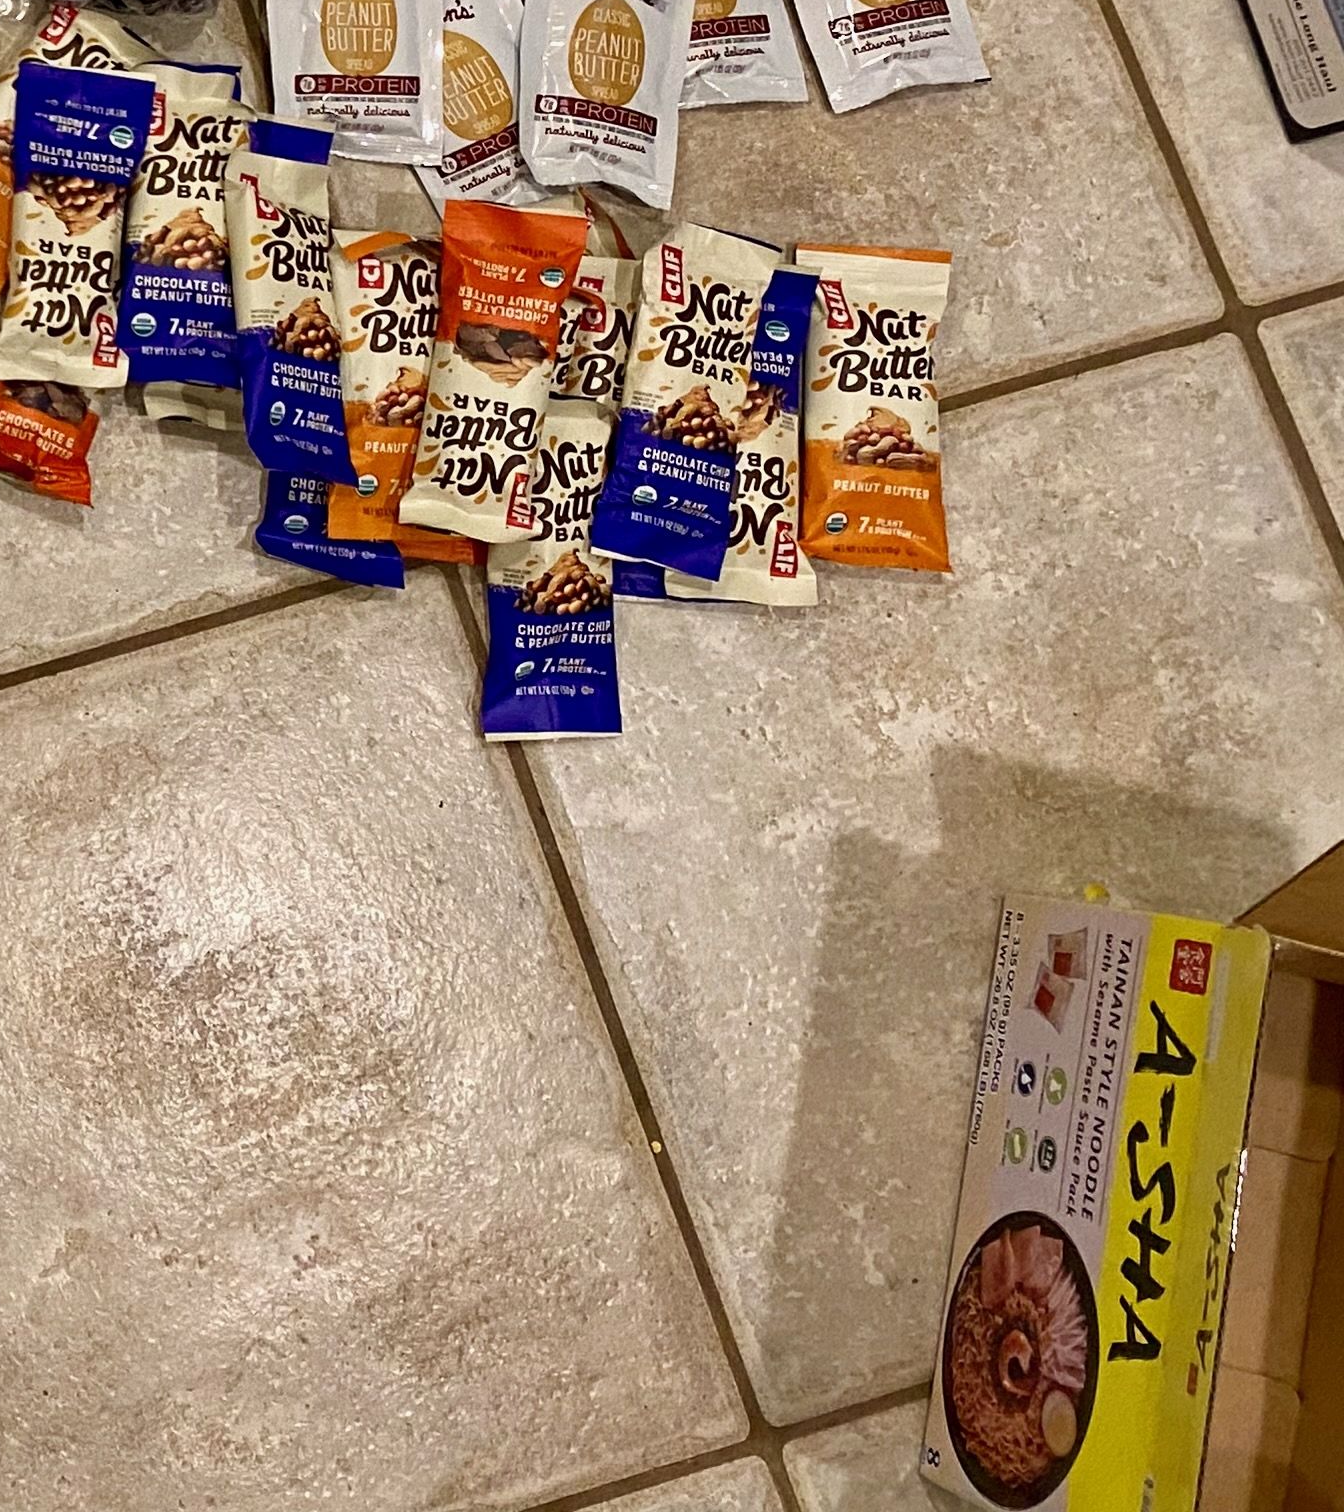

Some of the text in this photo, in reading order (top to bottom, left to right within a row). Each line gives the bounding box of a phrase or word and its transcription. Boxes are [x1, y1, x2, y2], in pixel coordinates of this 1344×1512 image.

[327, 2, 391, 26] PEANUT
[327, 28, 393, 52] BUTTER
[332, 78, 417, 93] PROTEIN
[364, 105, 410, 117] delicious
[545, 126, 646, 153] naturally delicious
[665, 249, 681, 300] CLIF
[676, 282, 753, 326] Nut
[827, 283, 849, 328] CLIF
[844, 309, 926, 347] Nut
[870, 382, 922, 401] BAR
[834, 479, 930, 500] PEANUT BUTTER
[515, 633, 612, 648] & PEANUT BUTTER
[518, 620, 610, 636] CHOCOLATE CHIP
[1066, 933, 1114, 1217] with Sesame Paste Sauce Pack
[1081, 939, 1133, 1223] TAINAN STYLE NOODLE
[1107, 1000, 1198, 1363] A-SHA
